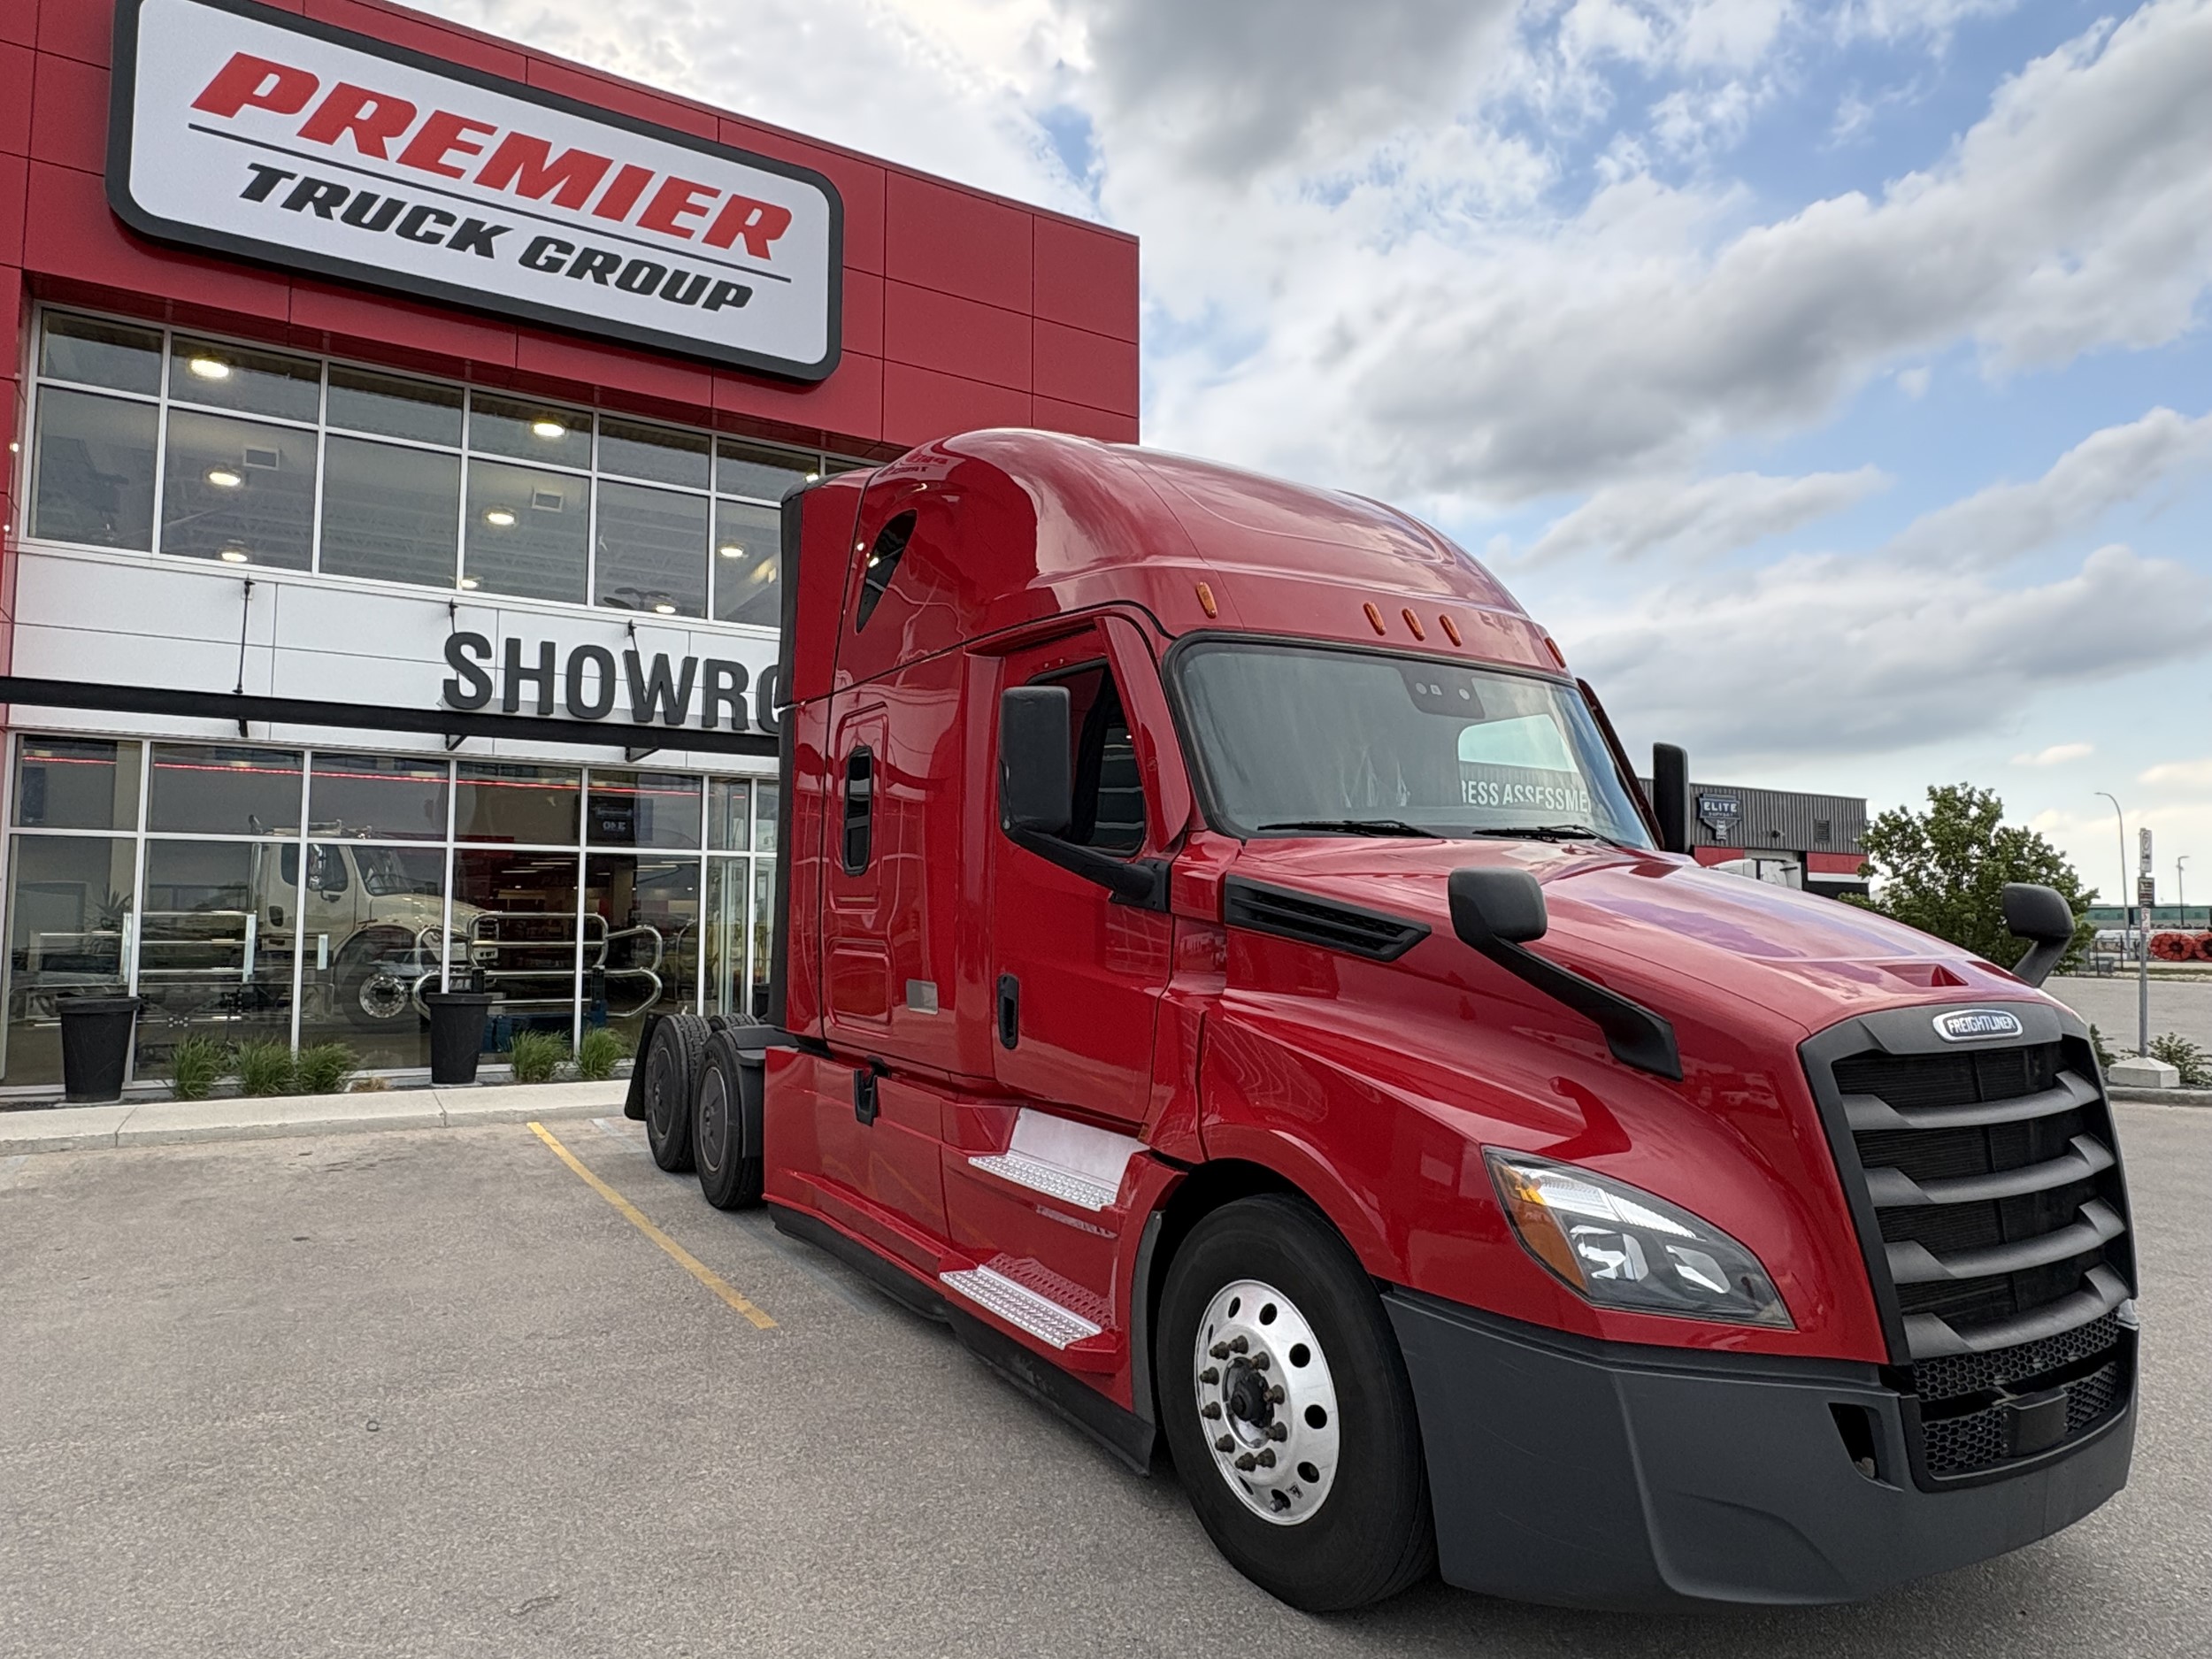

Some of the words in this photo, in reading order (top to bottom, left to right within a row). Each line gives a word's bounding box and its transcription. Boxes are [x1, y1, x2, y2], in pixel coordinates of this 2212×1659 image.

[190, 51, 792, 260] PREMIER
[239, 163, 513, 259] TRUCK
[518, 235, 754, 312] GROUP
[1703, 801, 1738, 812] ELITE
[1947, 1015, 2016, 1034] FREIGHTLINER
